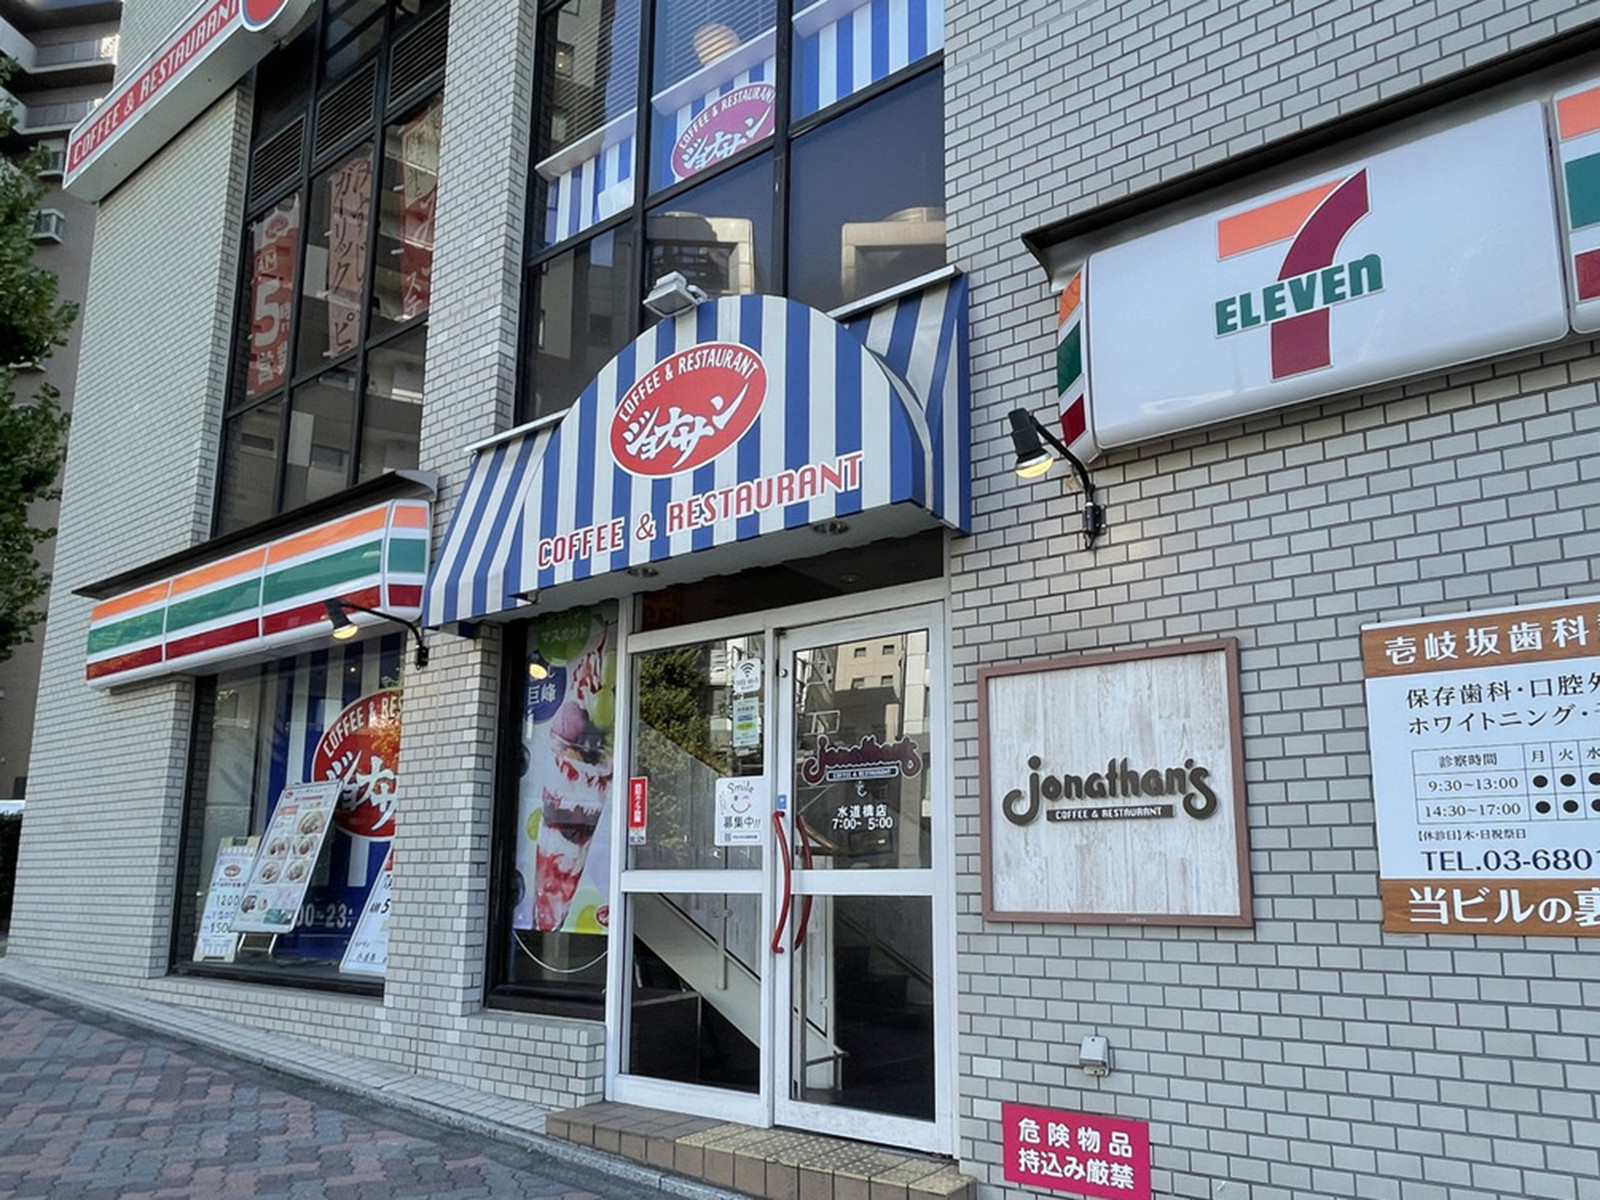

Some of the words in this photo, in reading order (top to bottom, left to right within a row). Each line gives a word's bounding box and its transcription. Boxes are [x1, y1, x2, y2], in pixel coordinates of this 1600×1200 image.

[73, 104, 122, 164] COFFEE
[123, 92, 135, 116] &
[678, 113, 710, 150] COFFEE
[711, 106, 719, 118] &
[333, 165, 353, 352] ガーリックピ
[618, 371, 662, 423] COFFEE
[664, 364, 675, 382] &
[677, 348, 760, 380] RESTAURANT
[537, 519, 624, 569] COFFEE
[635, 512, 657, 542] &
[666, 452, 864, 536] RESTAURANT
[1384, 613, 1600, 666] 壱岐坂歯科
[322, 706, 365, 758] COFFEE
[1530, 748, 1545, 763] 月
[1558, 747, 1574, 761] 火
[1438, 751, 1499, 769] 診察時間
[837, 803, 888, 819] 水道橋店
[1002, 755, 1218, 827] jonathan's
[1055, 809, 1089, 820] COFFEE
[1091, 808, 1099, 819] &
[1101, 806, 1162, 818] RESTAURANT
[1017, 1116, 1133, 1159] 危険物品
[1017, 1146, 1135, 1190] 持込み厳禁
